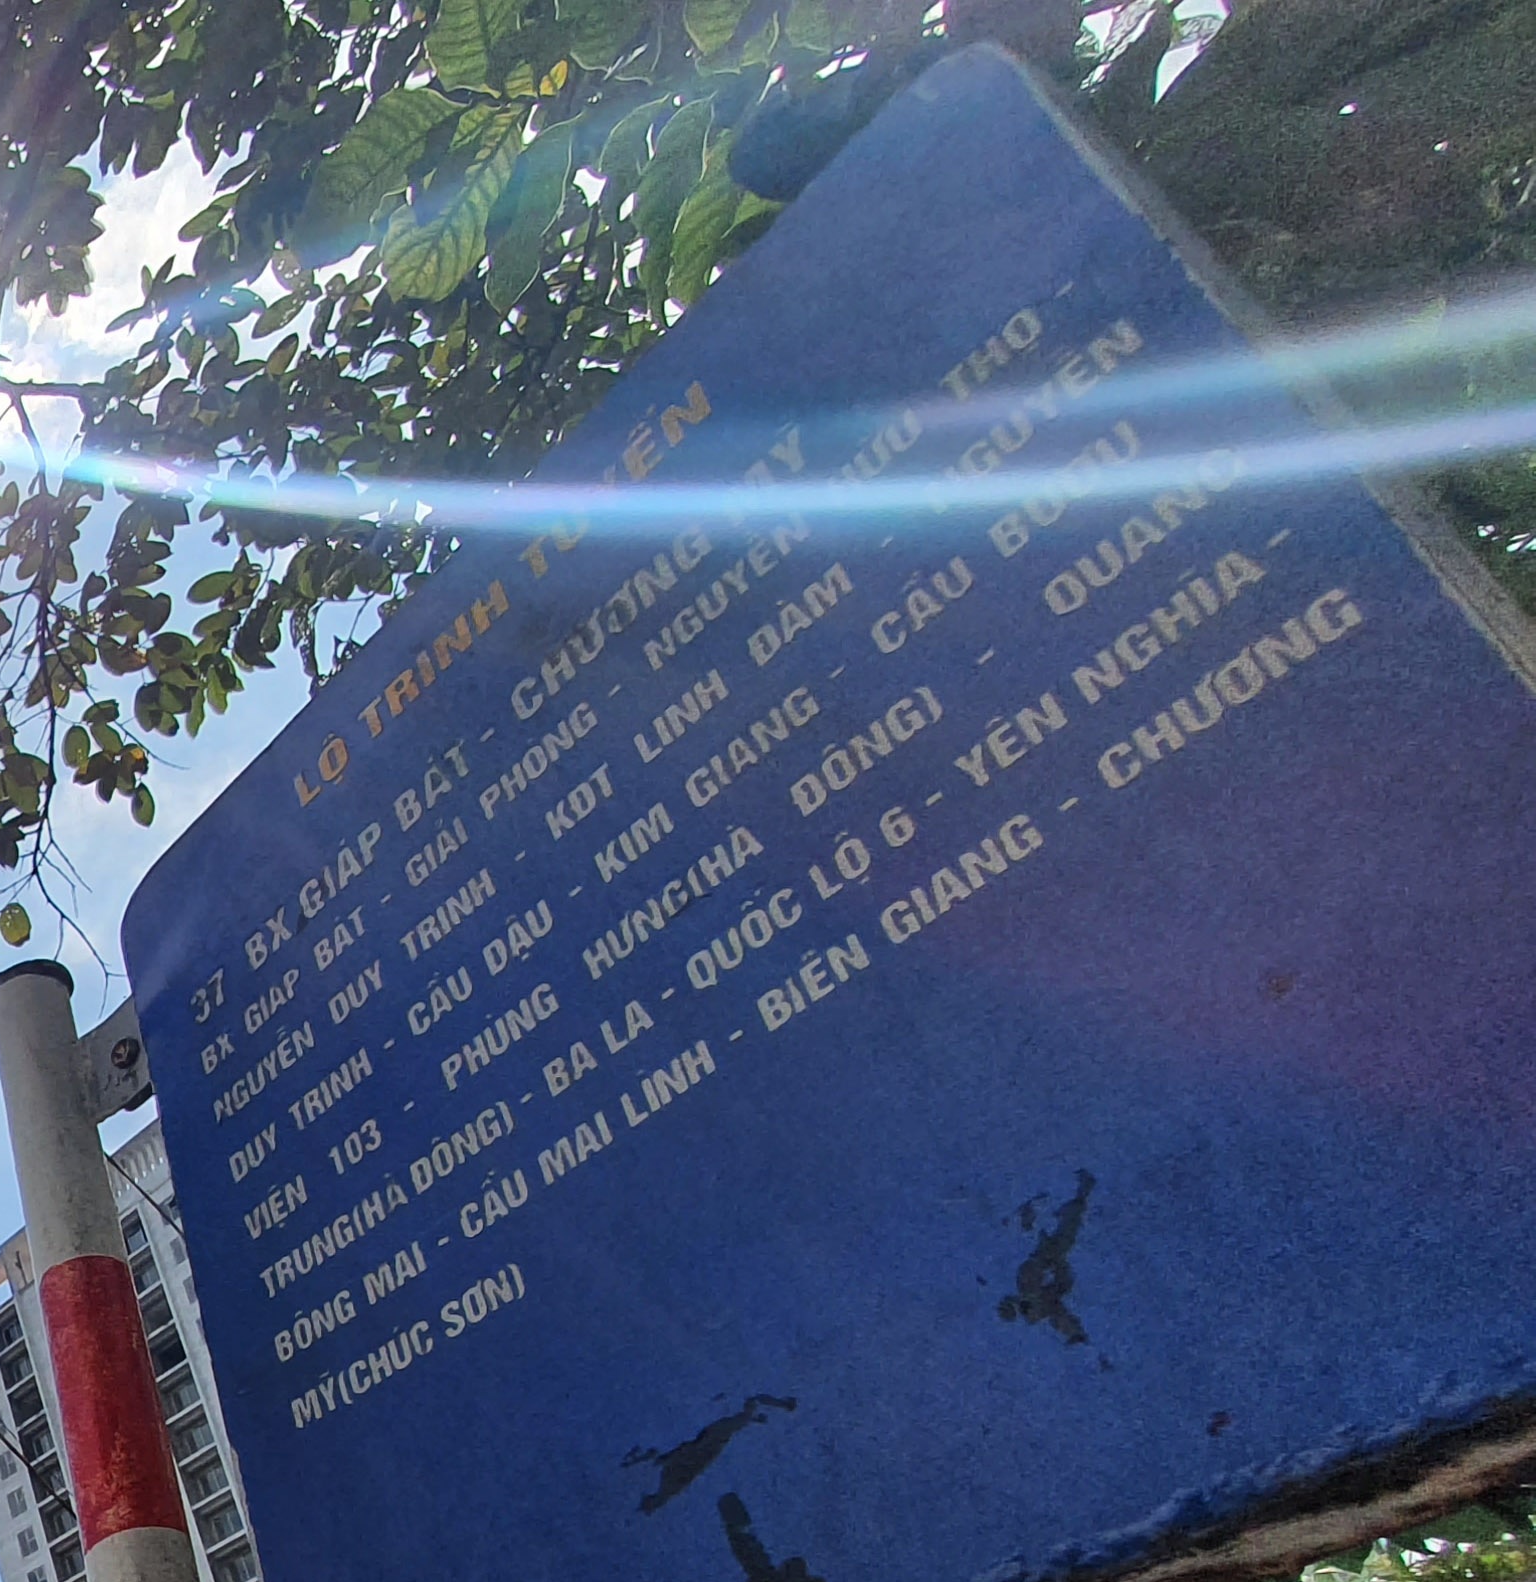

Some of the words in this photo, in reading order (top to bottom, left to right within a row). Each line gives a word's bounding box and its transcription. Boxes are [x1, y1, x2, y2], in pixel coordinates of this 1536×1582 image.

[293, 733, 349, 808] LỘ
[518, 380, 712, 579] TUẾN
[328, 960, 384, 1026] DUY
[399, 867, 497, 962] TRINH
[633, 668, 729, 763] LINH
[931, 316, 1144, 510] GUYỄN
[189, 967, 226, 1025] 37
[244, 905, 293, 972] BX
[298, 822, 383, 919] GIÁP
[394, 738, 472, 832] BÁT
[199, 1032, 235, 1076] BX
[229, 1122, 277, 1184] DUY
[288, 1047, 373, 1131] TRINH
[595, 802, 675, 883] KIM
[684, 685, 821, 808] GIANG
[362, 1240, 428, 1306] MAI
[537, 1111, 614, 1187] MAI
[756, 933, 871, 1032] BIÊN
[880, 814, 1045, 944] GIANG
[1097, 588, 1365, 790] CHƯƠNG
[541, 1040, 599, 1098] BA
[600, 1000, 655, 1055] LA
[685, 887, 803, 991] QUỐC
[808, 830, 872, 901] LỘ
[878, 807, 917, 848] 6
[953, 693, 1069, 788] YÊN
[328, 1118, 382, 1176] 103
